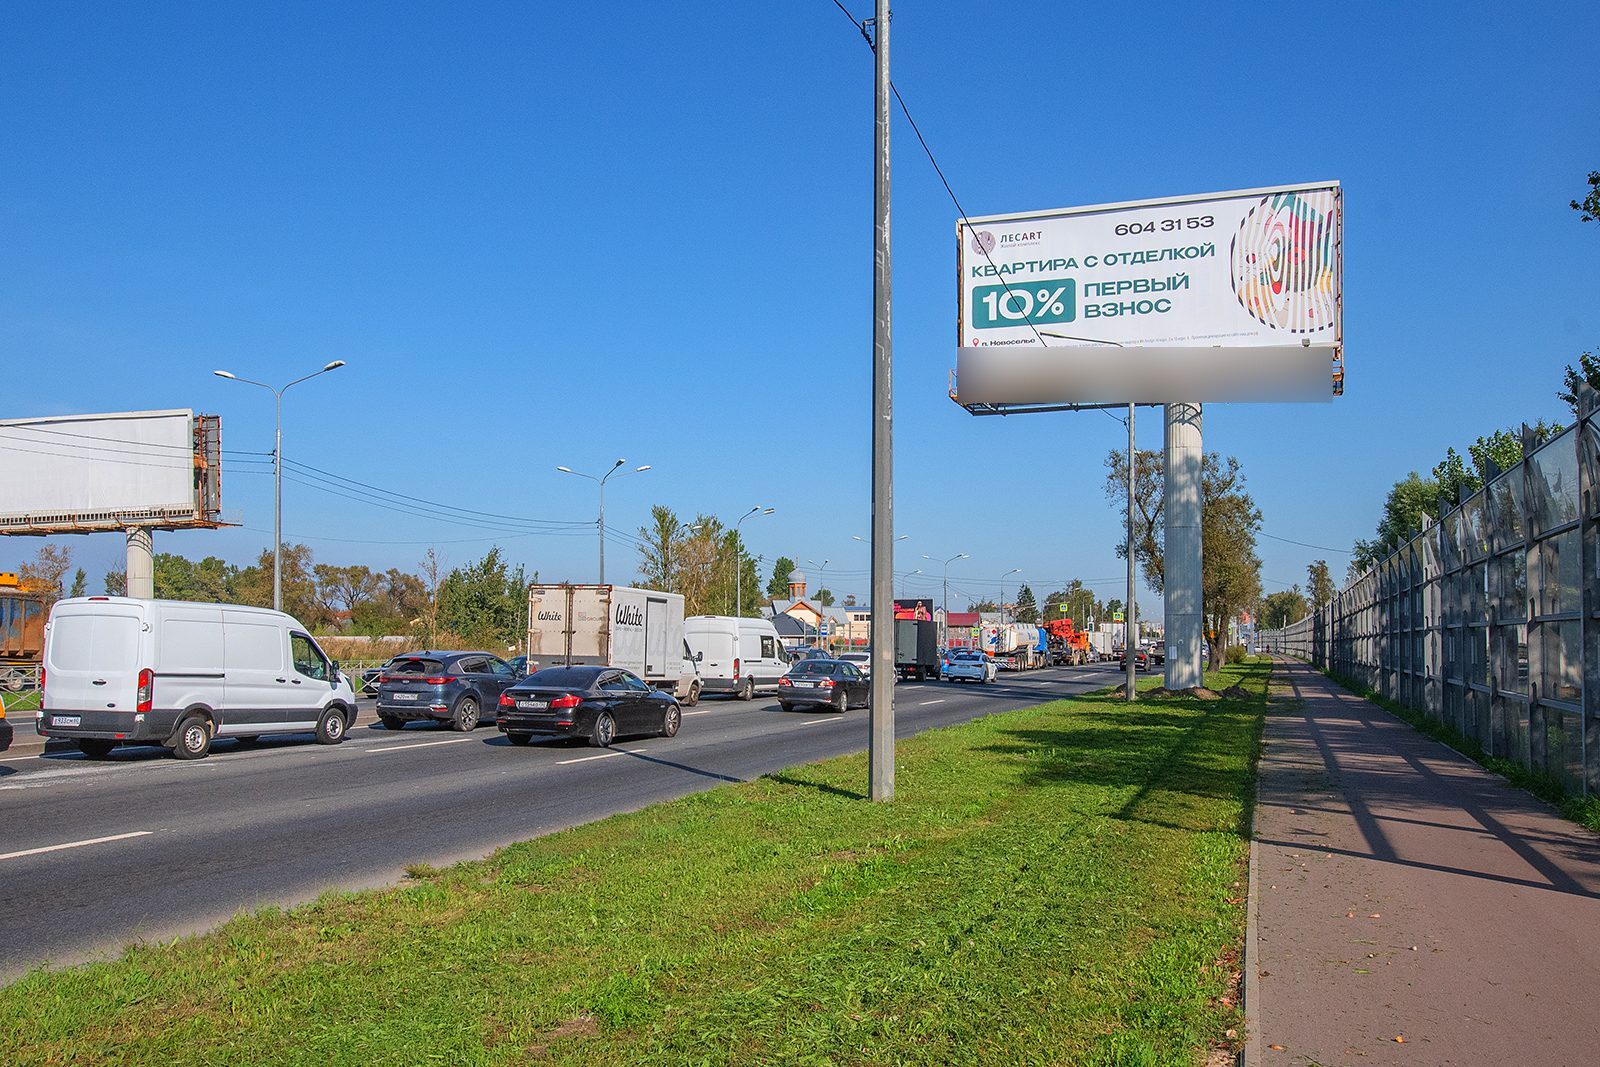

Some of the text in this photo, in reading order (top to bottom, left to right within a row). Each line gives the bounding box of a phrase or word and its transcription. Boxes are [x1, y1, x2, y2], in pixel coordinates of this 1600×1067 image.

[1114, 215, 1215, 236] 604 31 53
[971, 242, 1216, 278] КВАРТИРА С ОТДЕЛКОЙ
[1084, 273, 1190, 297] ПЕРВЫЙ
[982, 286, 1065, 321] 10%
[1084, 298, 1172, 319] ВЗНОС
[990, 338, 1036, 346] Новоселье
[537, 610, 562, 621] White
[615, 603, 643, 626] White
